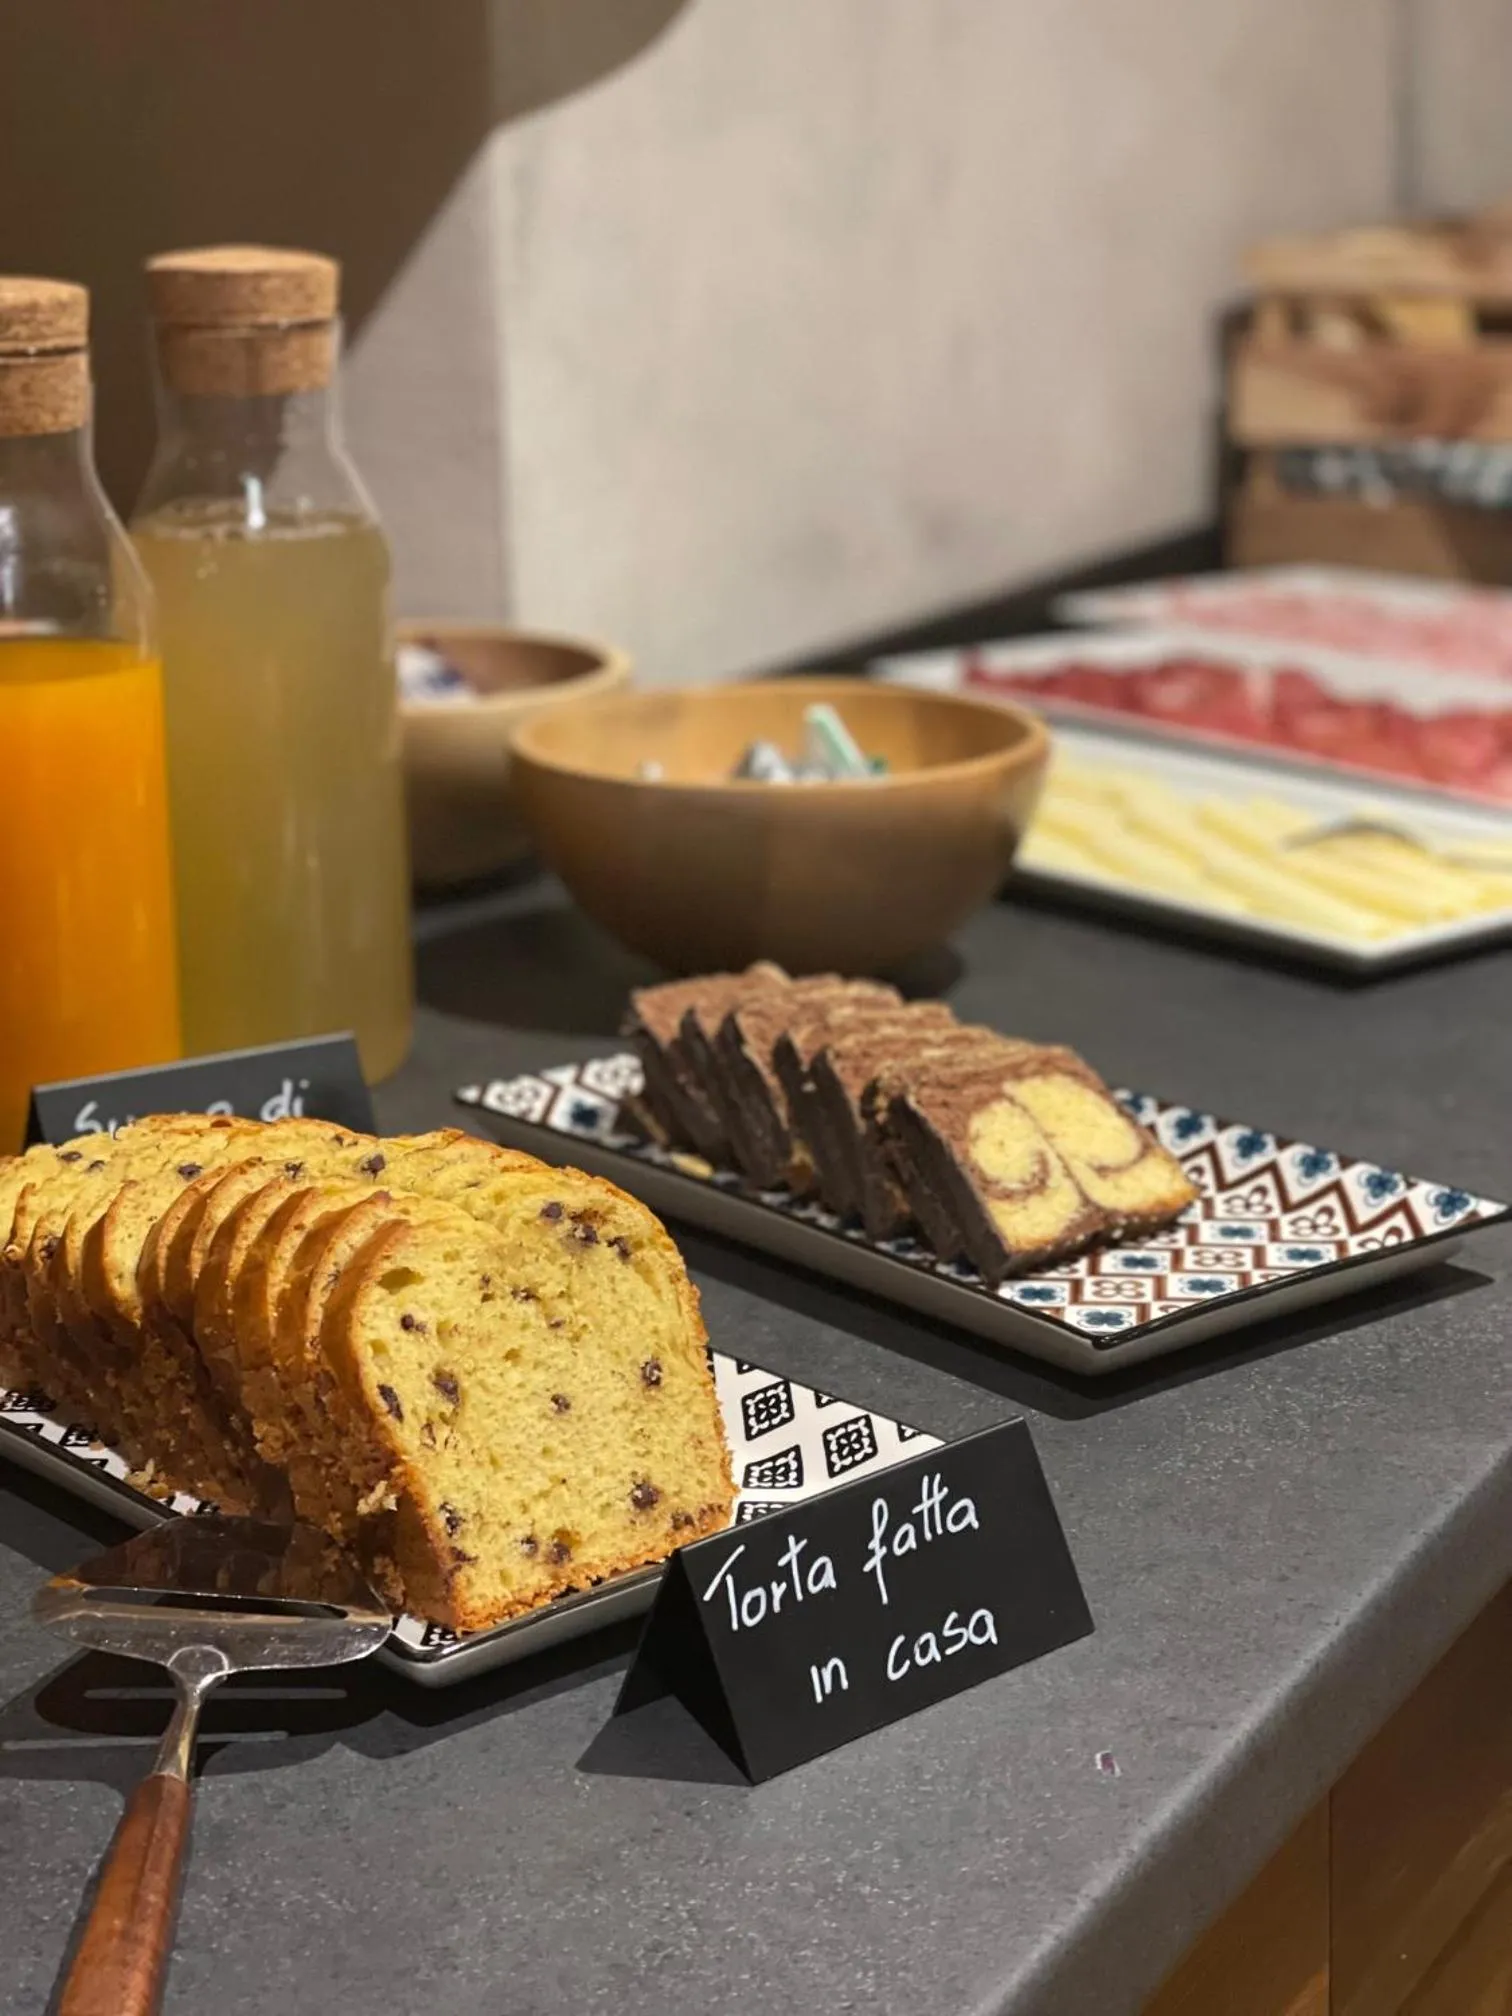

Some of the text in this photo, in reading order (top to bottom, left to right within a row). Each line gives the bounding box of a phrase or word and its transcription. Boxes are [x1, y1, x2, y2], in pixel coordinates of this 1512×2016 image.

[260, 1078, 311, 1123] di
[703, 1472, 980, 1631] Torta fatta
[810, 1608, 998, 1703] in casa
